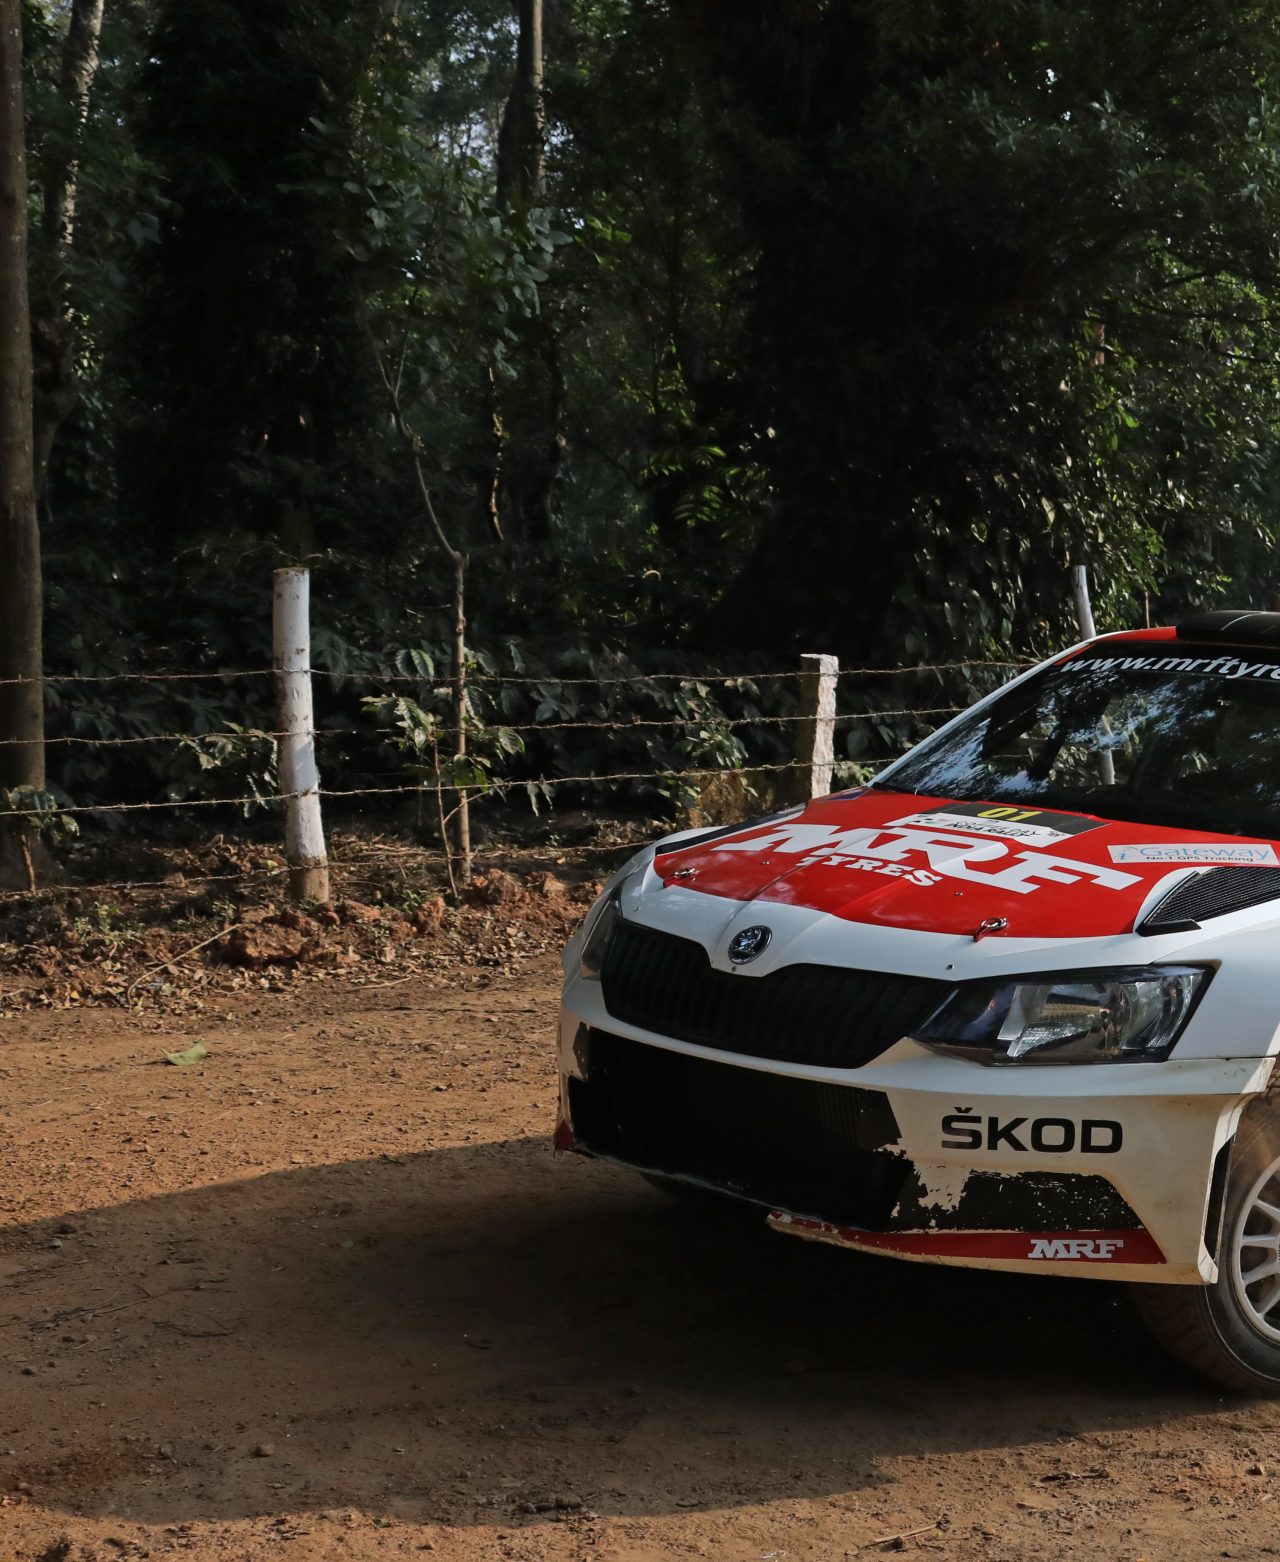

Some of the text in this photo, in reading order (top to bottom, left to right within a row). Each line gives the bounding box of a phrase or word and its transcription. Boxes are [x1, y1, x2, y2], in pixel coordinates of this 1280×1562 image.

[977, 807, 1042, 822] 01
[711, 824, 1144, 894] MRF
[796, 853, 943, 887] TYRES
[941, 1106, 1123, 1154] ŠKOD
[1028, 1239, 1124, 1259] MRF
